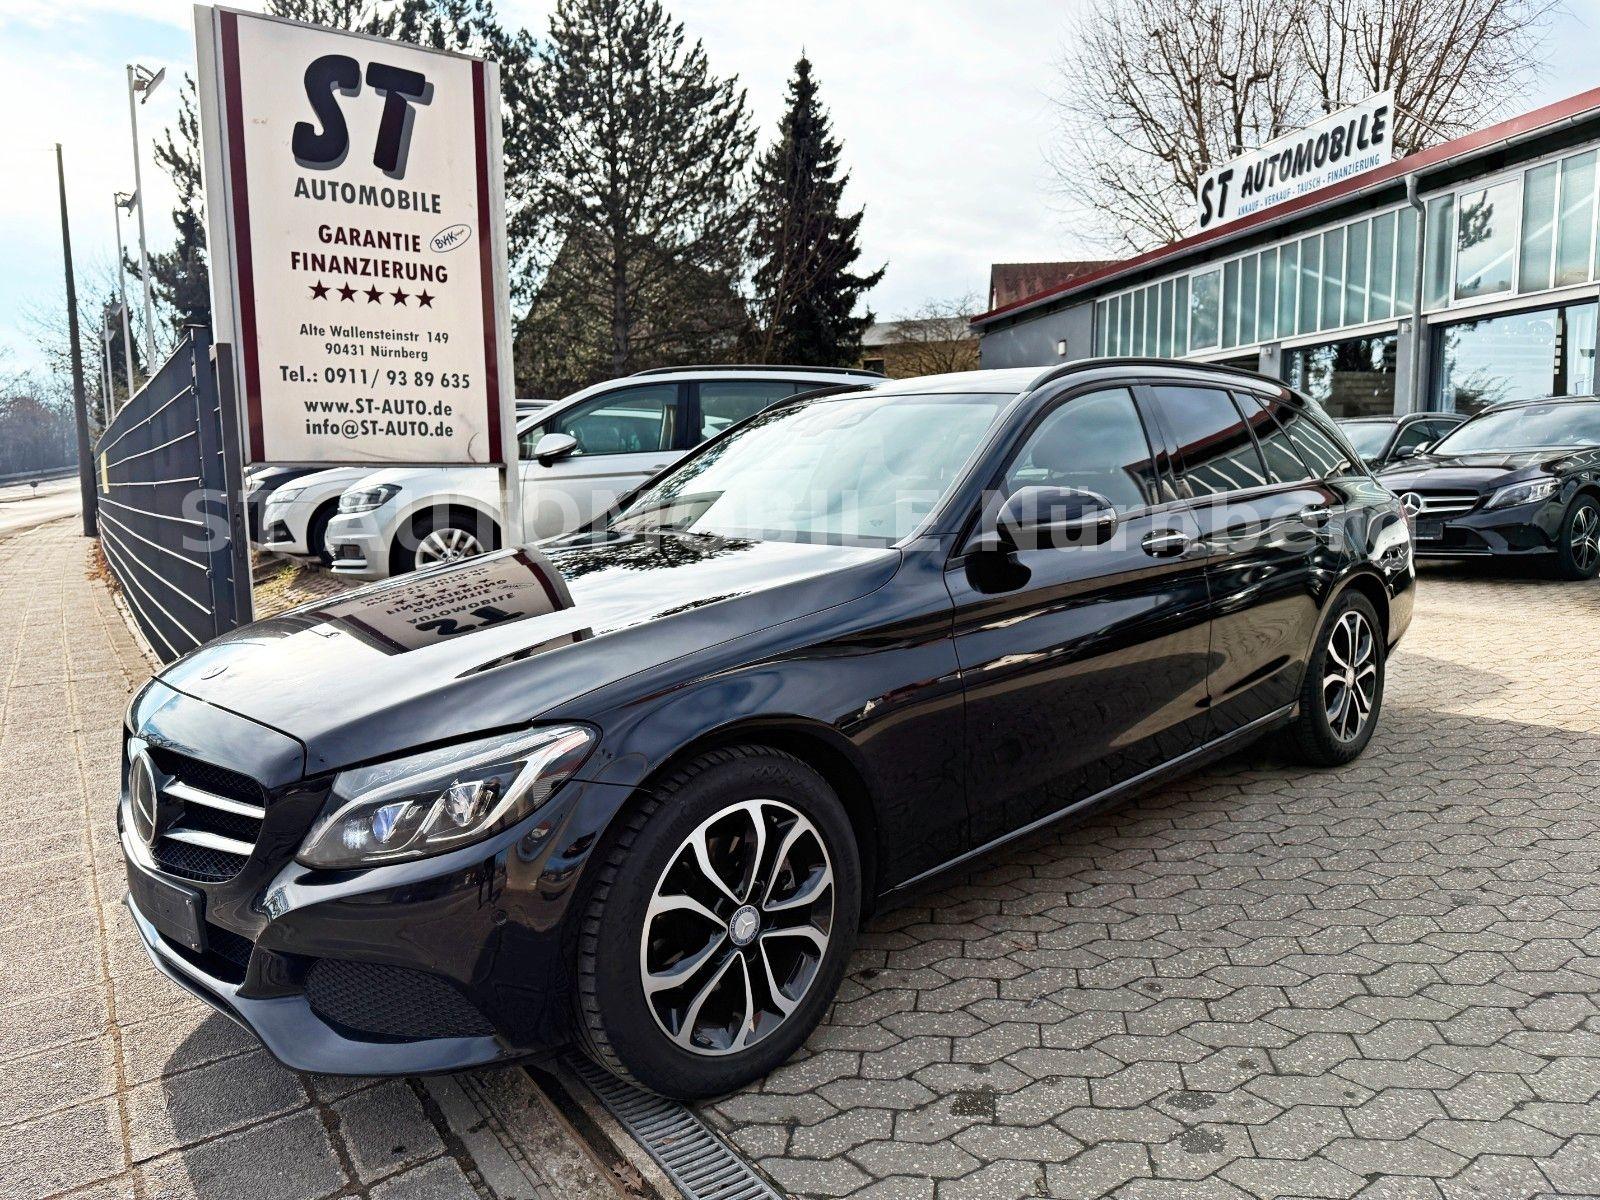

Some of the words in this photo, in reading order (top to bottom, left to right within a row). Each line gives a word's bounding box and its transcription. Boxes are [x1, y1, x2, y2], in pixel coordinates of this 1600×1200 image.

[291, 54, 434, 181] ST
[1200, 168, 1234, 228] ST
[1241, 105, 1389, 199] AUTOMOBILE
[294, 177, 441, 214] AUTOMOBILE
[1237, 200, 1259, 216] ANKAUF
[1264, 189, 1291, 207] VERKAUF
[1297, 177, 1321, 196] TAUSCH
[1327, 153, 1380, 182] FINANZIERUNG
[318, 224, 421, 252] GARANTIE
[291, 251, 448, 284] FINANZIERUNG
[300, 323, 326, 337] Alte
[330, 325, 420, 342] Wallensteinstr
[427, 331, 449, 344] 149
[325, 343, 364, 356] 90431
[371, 345, 428, 362] Nürnberg
[280, 365, 318, 383] Tel.:
[387, 370, 408, 386] 93
[414, 371, 434, 388] 89
[440, 373, 470, 389] 635
[304, 398, 452, 417] www.ST-AUTO.de
[305, 419, 453, 440] info@ST-AUTO.de
